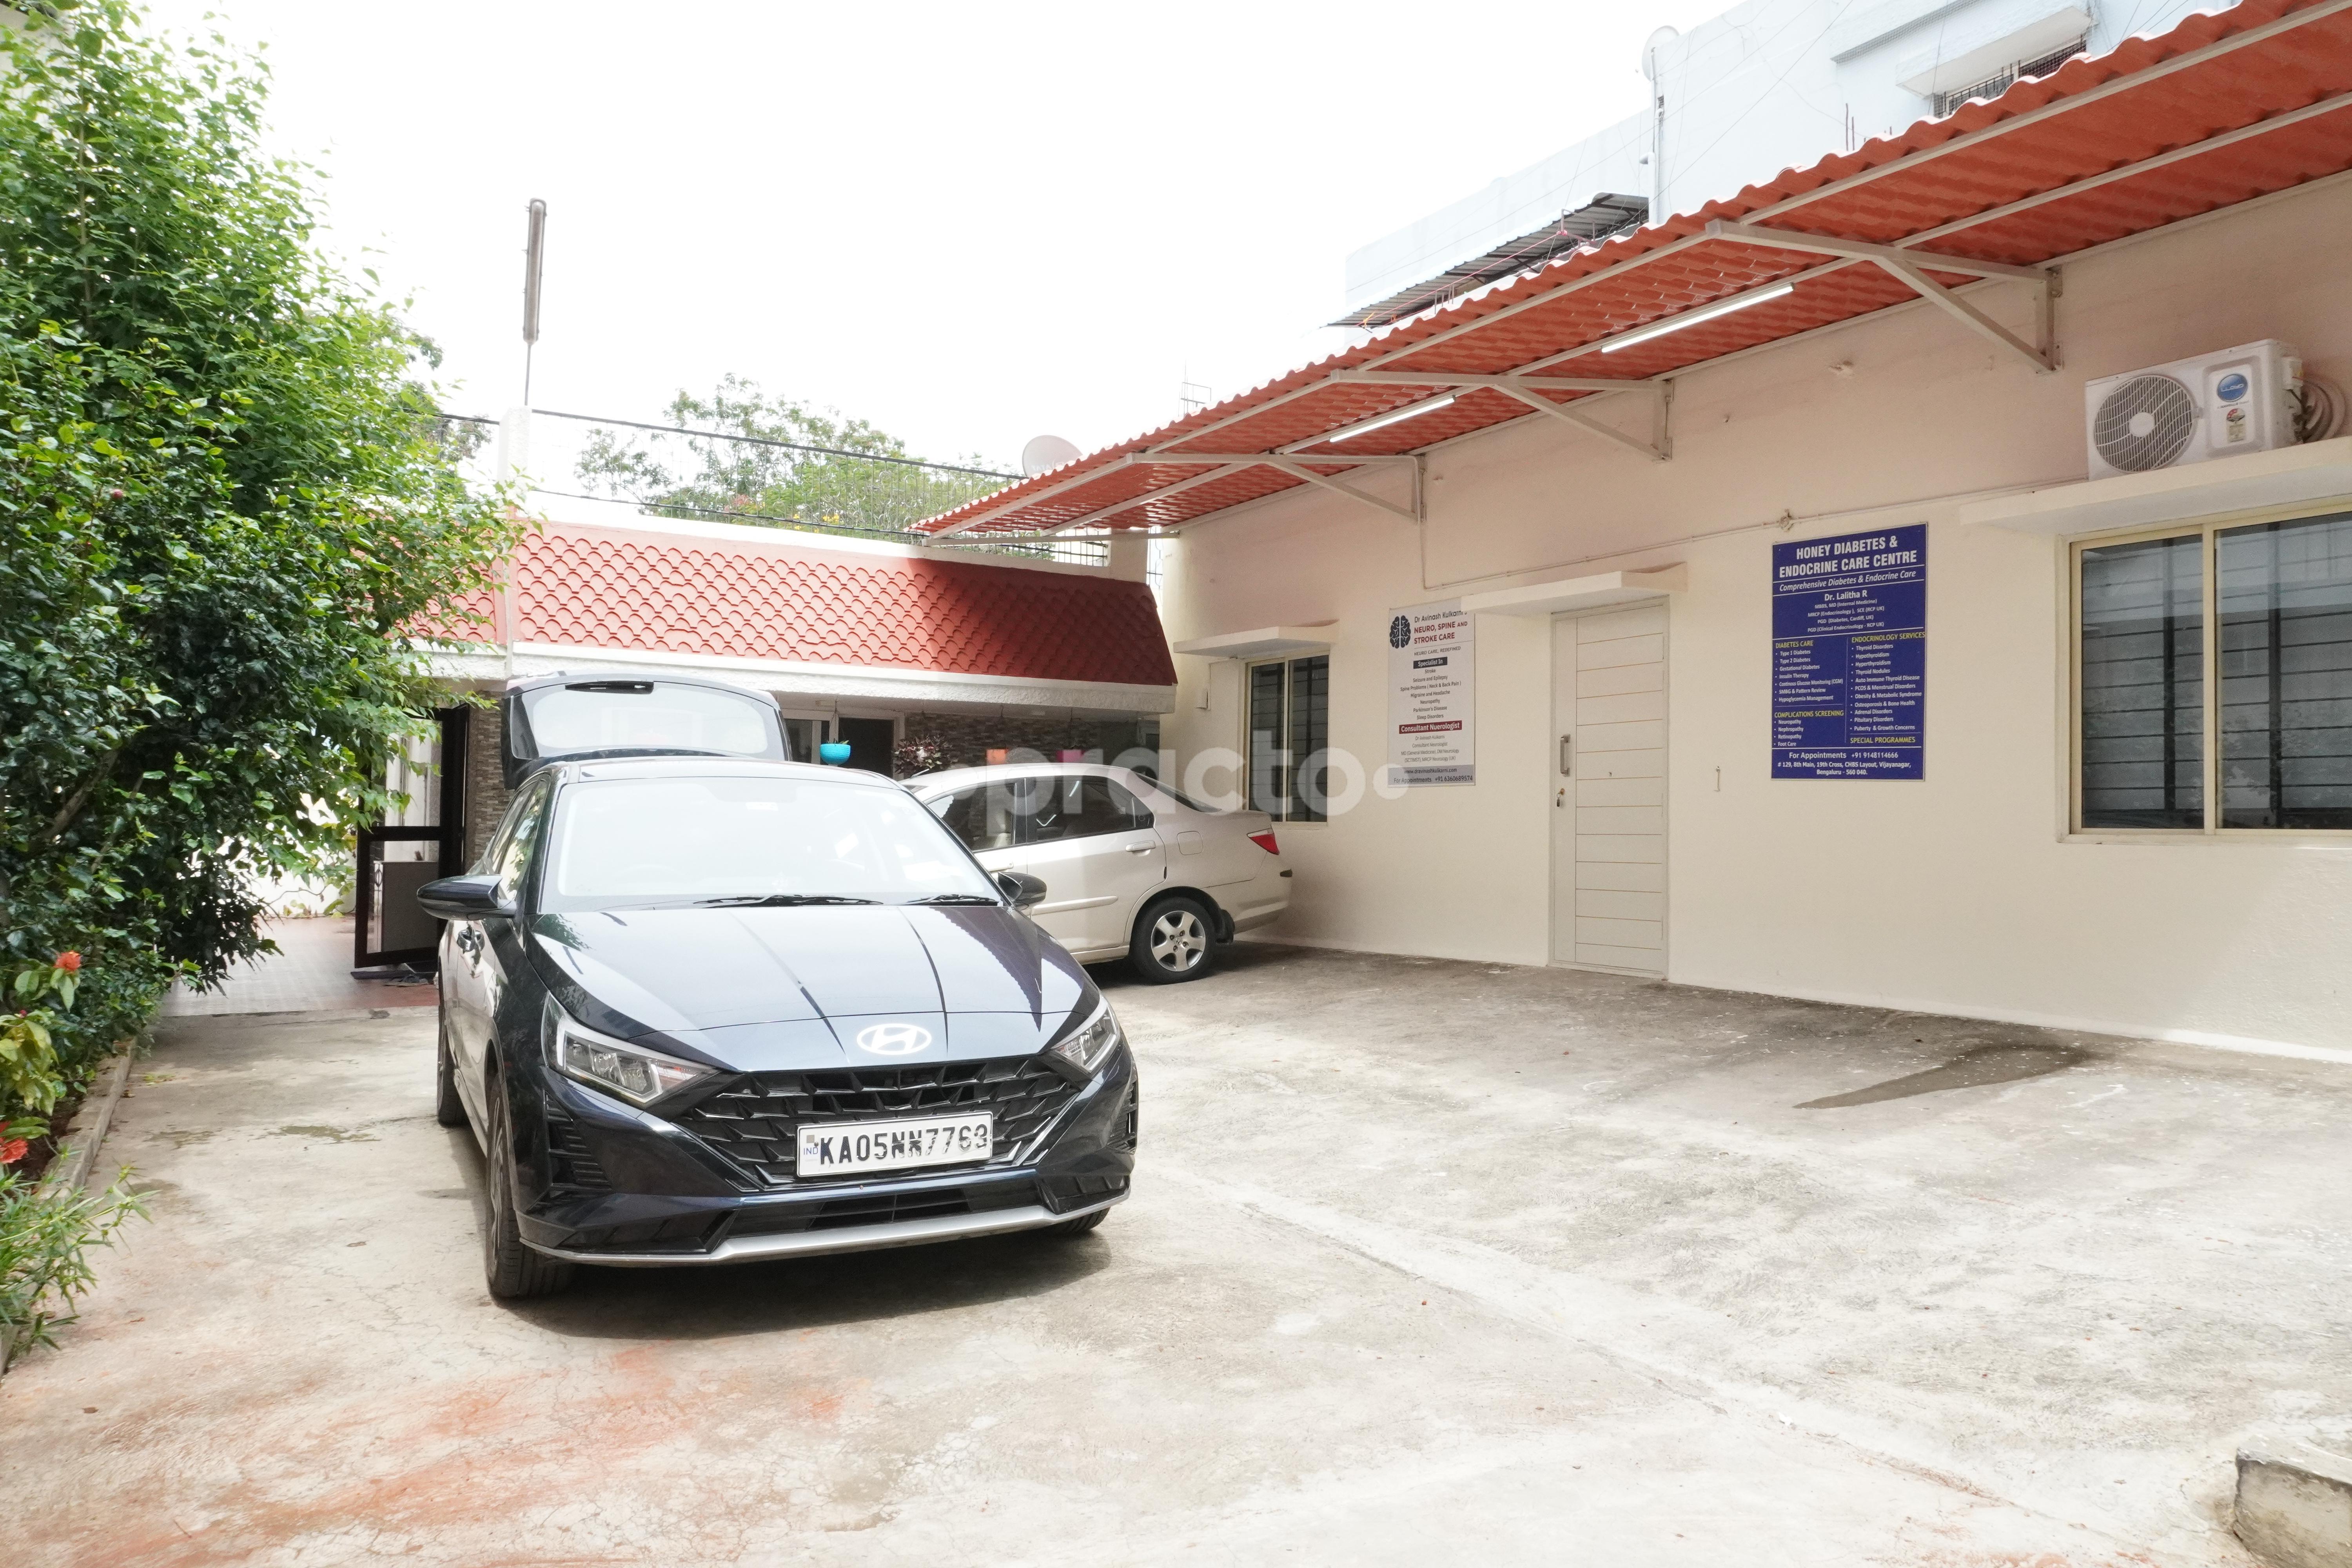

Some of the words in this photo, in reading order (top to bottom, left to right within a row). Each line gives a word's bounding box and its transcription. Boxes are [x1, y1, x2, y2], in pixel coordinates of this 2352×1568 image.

[1796, 544, 1831, 560] HONEY
[1834, 537, 1886, 555] DIABETES
[1889, 535, 1898, 547] &
[1779, 560, 1838, 578] ENDOCRINE
[1842, 556, 1869, 570] CARE
[1873, 550, 1917, 566] CENTRE
[1779, 580, 1826, 592] Comprehensive
[1828, 576, 1856, 586] Diabetes
[1866, 572, 1898, 582] Endocrine
[1900, 570, 1916, 578] Care
[1837, 592, 1860, 600] Lalitha
[1421, 613, 1441, 622] Avinash
[1414, 625, 1436, 633] NEURO,
[1438, 621, 1455, 630] SPINE
[1414, 635, 1437, 644] STROKE
[1851, 634, 1898, 643] ENDOCRINOLOGY
[803, 1147, 818, 1155] IND
